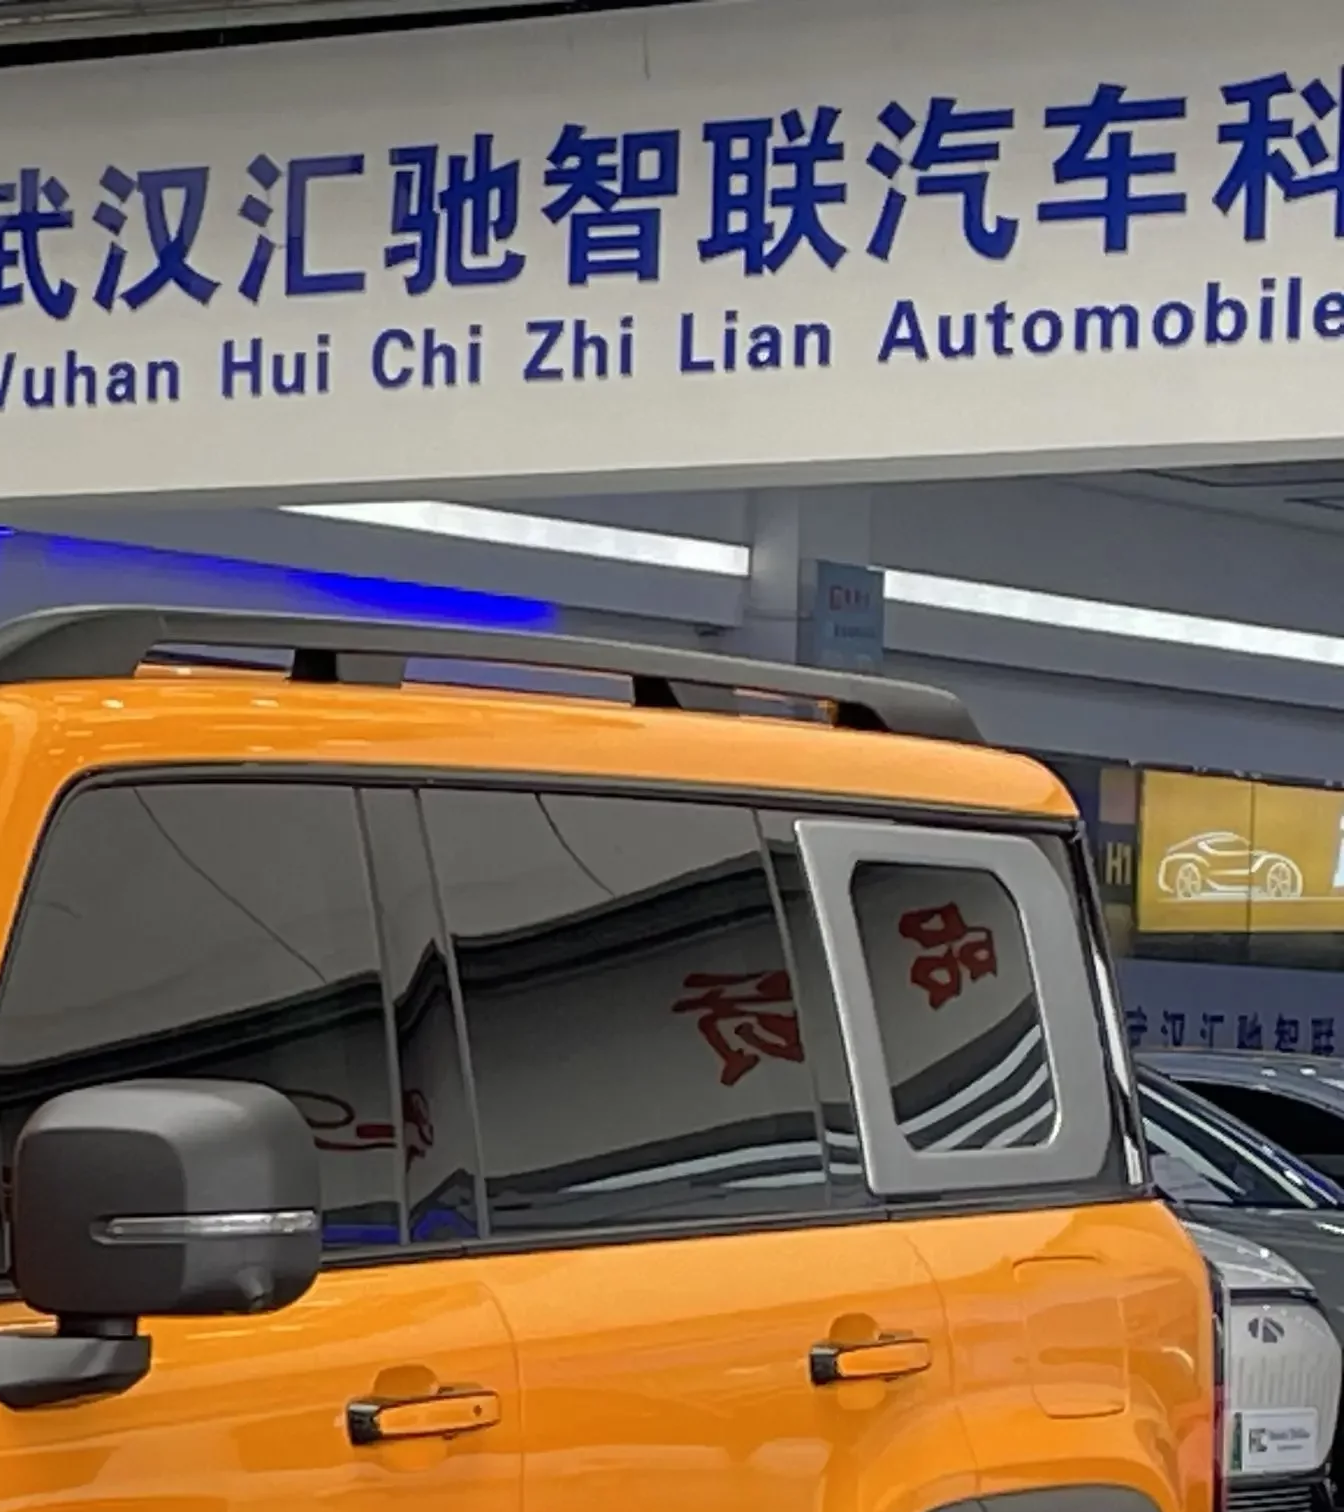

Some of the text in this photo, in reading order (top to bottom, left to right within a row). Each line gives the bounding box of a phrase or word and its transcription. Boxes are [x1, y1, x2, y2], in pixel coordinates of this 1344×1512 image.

[221, 334, 330, 399] Hui
[371, 325, 483, 388] Chi
[523, 315, 634, 382] Zhi
[679, 310, 832, 374] Lian
[878, 276, 1344, 363] Automobile
